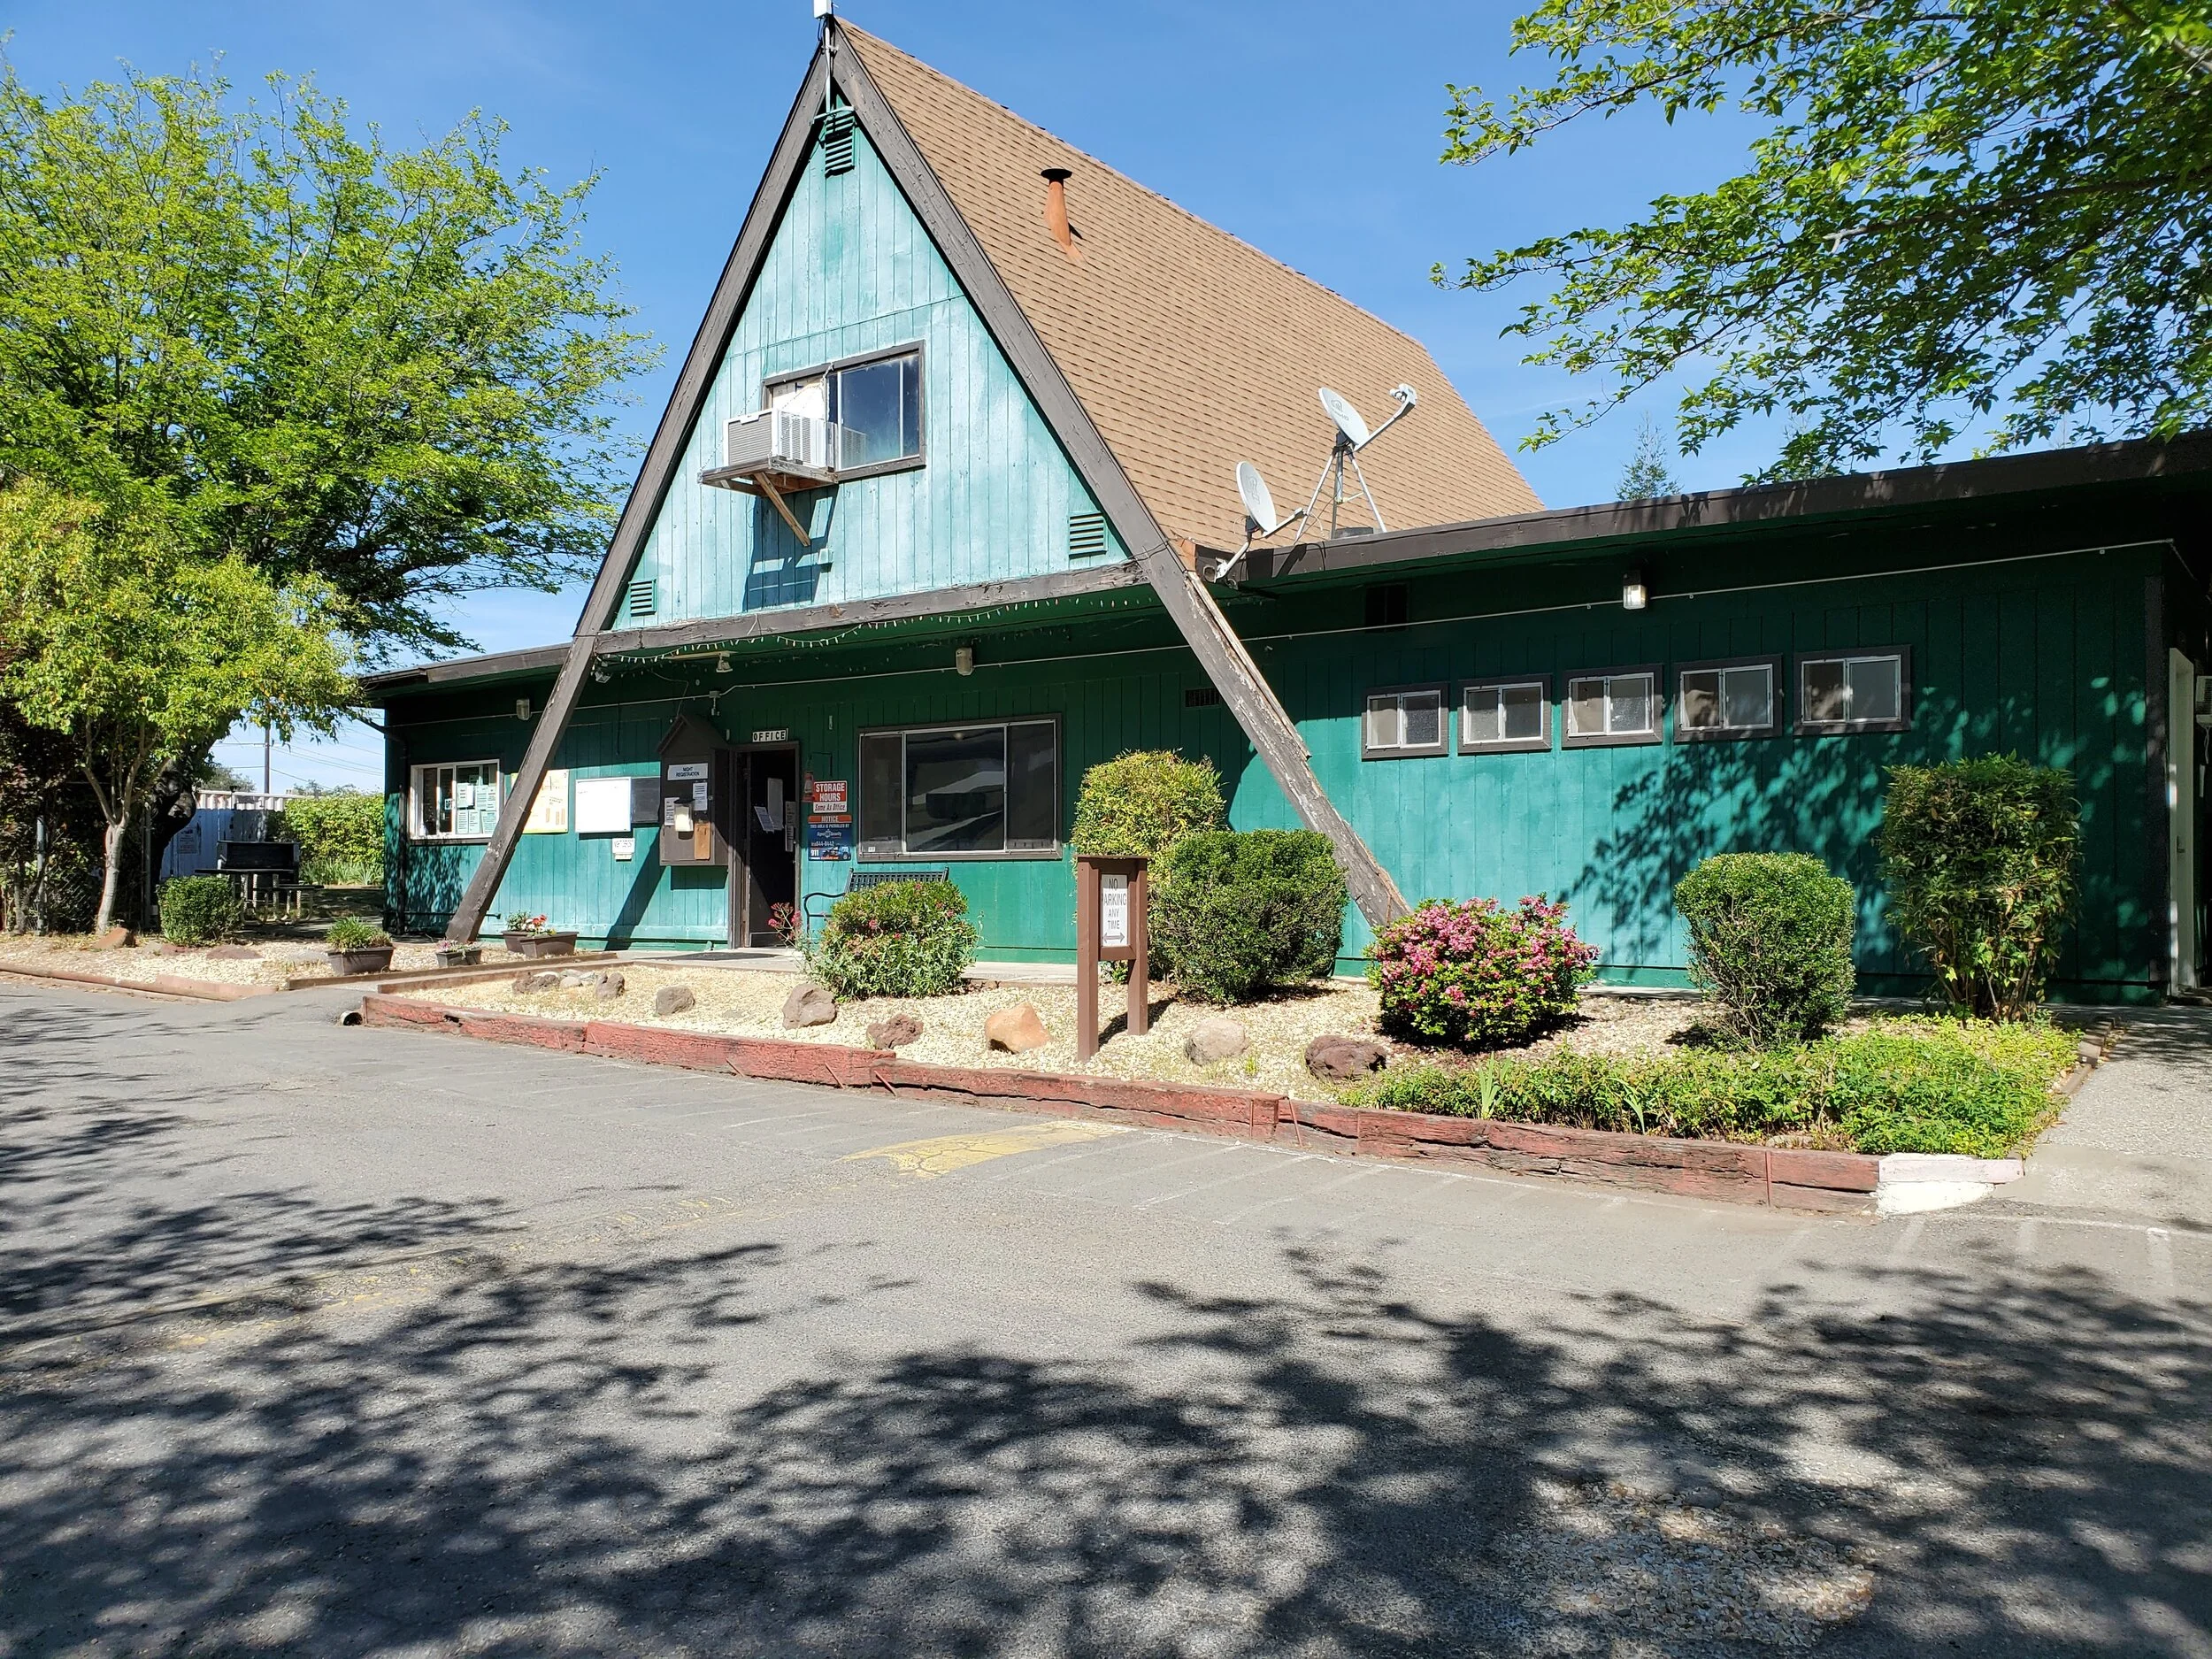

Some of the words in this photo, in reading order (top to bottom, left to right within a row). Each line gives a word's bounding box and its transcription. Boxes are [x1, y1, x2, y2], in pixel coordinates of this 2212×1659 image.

[754, 731, 785, 741] OFFICE
[816, 783, 845, 792] STORAGE
[819, 793, 841, 802] HOURS
[1109, 878, 1118, 890] NO
[1108, 909, 1120, 918] ANY
[1108, 920, 1120, 929] TIME
